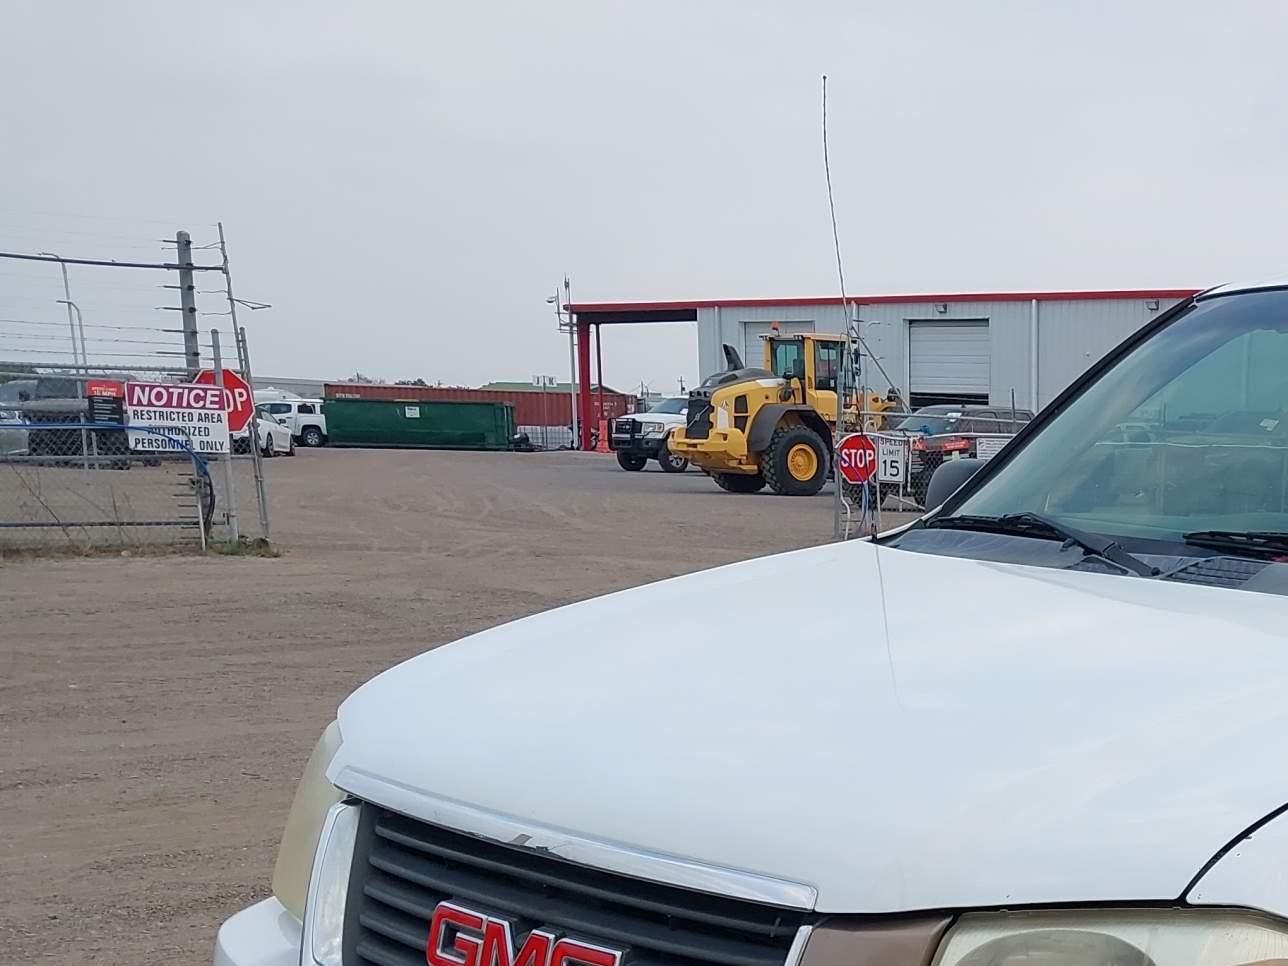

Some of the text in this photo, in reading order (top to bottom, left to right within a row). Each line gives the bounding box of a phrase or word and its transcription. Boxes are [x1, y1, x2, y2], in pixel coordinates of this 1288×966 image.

[132, 386, 221, 409] NOTICE
[133, 410, 194, 422] RESTRICTED
[197, 412, 223, 424] AREA
[200, 440, 225, 451] ONLY
[882, 448, 900, 456] LIMIT
[841, 448, 874, 468] STOP
[882, 459, 900, 477] 15
